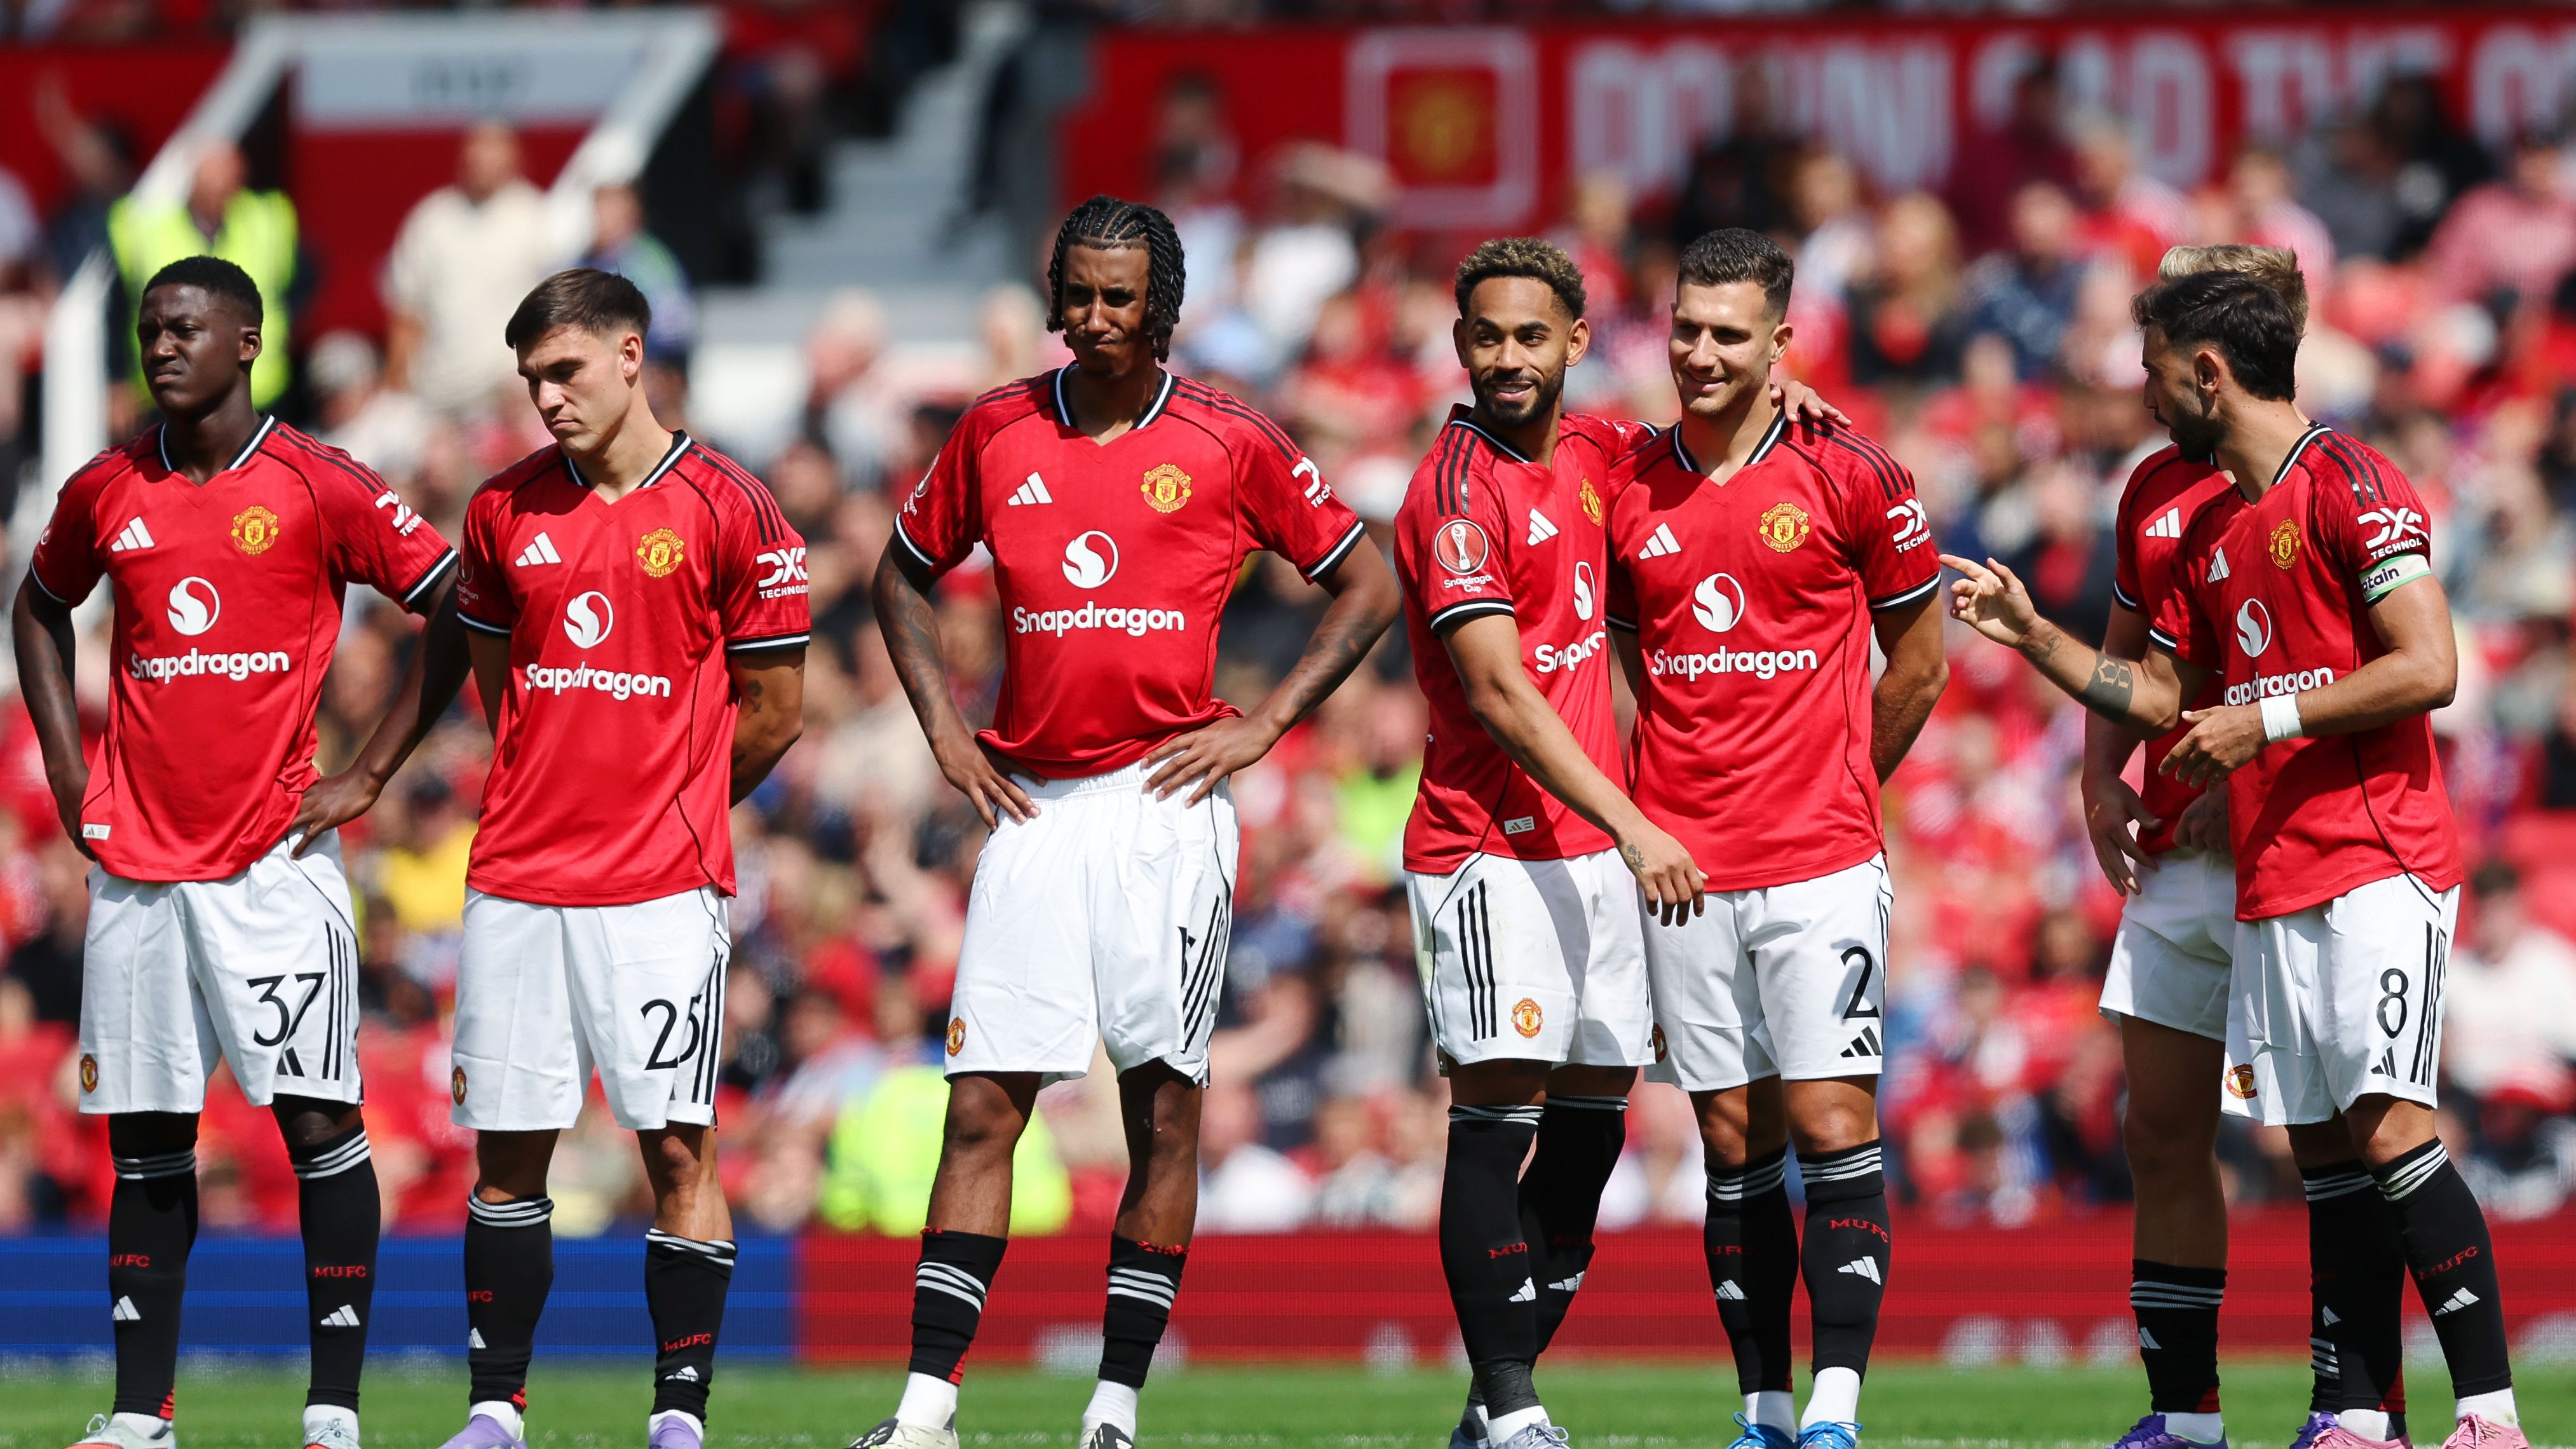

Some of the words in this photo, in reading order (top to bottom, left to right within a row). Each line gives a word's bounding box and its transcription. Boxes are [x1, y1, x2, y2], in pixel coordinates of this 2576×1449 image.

[1147, 467, 1188, 486] MANCHESTER
[1151, 500, 1179, 510] UNITED
[1764, 507, 1805, 523] MANCHESTER
[643, 532, 682, 551] MANCHESTER
[1770, 540, 1799, 550] UNITED
[2370, 538, 2423, 560] TECHNOL
[644, 563, 671, 575] UNITED
[1463, 584, 1482, 594] Cup
[1013, 601, 1185, 637] Snapdragon
[130, 647, 290, 684] Snapdragon
[1651, 645, 1817, 682] Snapdragon
[524, 661, 671, 701] Sapdragon
[2225, 667, 2335, 707] apdragon
[1840, 945, 1881, 1020] 2
[246, 971, 327, 1047] 37
[2376, 968, 2409, 1039] 8
[640, 995, 703, 1071] 25
[1829, 1218, 1888, 1243] MUFC
[111, 1253, 151, 1268] UFC
[314, 1264, 367, 1278] MUFC
[665, 1333, 712, 1352] MUFC
